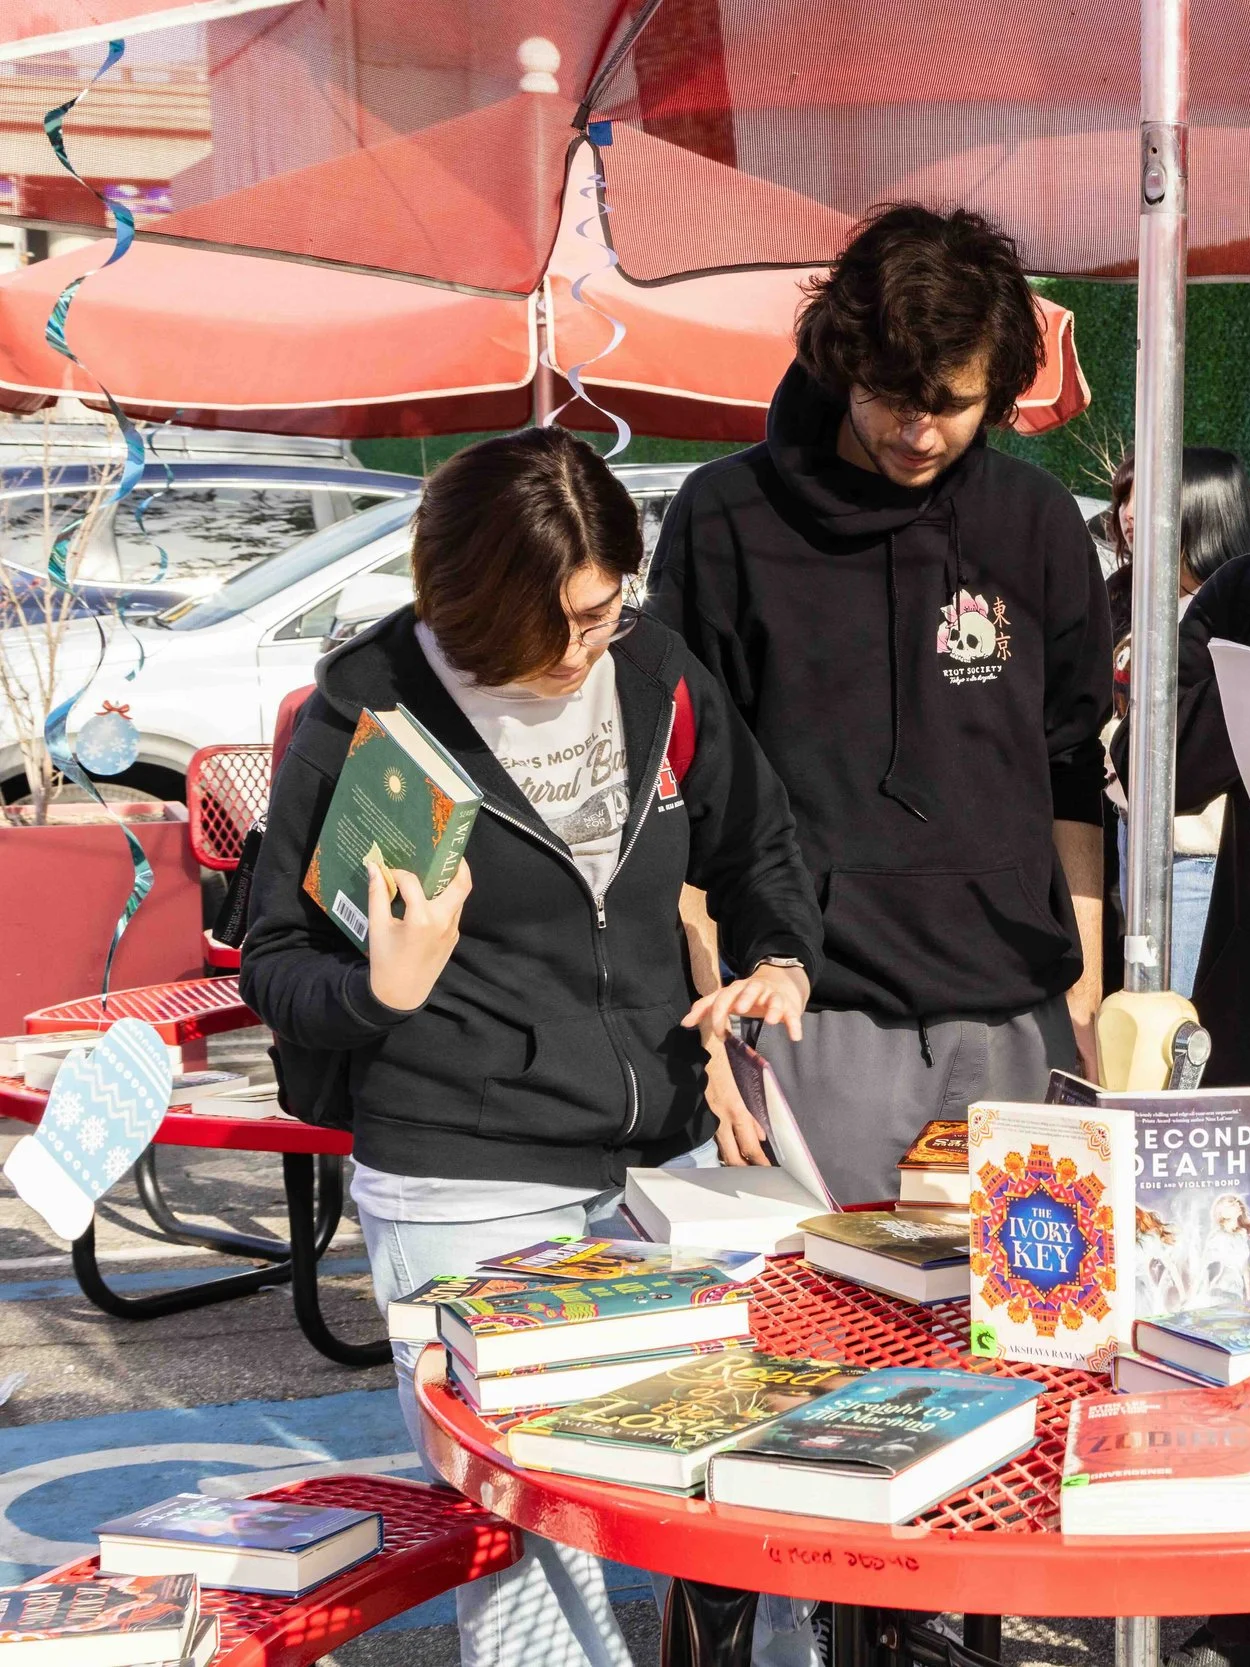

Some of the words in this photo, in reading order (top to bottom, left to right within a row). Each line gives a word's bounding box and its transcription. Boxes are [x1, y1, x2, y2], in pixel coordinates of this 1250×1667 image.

[991, 596, 1012, 661] 東京
[942, 668, 966, 677] RIOT
[967, 665, 1002, 674] SOCIETY
[501, 756, 541, 769] EAR'S
[547, 732, 599, 766] MODEL
[519, 766, 582, 806] tural
[582, 810, 604, 825] NEW
[585, 818, 606, 829] FOR
[451, 820, 471, 848] WE
[440, 850, 461, 876] ALL
[1135, 1149, 1246, 1178] DEATH
[1140, 1181, 1161, 1190] EDIE
[1178, 1180, 1211, 1188] VIOLET
[1215, 1179, 1241, 1187] BOND
[1032, 1207, 1052, 1219] THE
[1009, 1216, 1075, 1244] IVORY
[1012, 1240, 1074, 1274] KEY
[1009, 1345, 1049, 1357] AKSHAYA
[1052, 1350, 1085, 1361] RAMAN
[824, 1400, 923, 1415] Straight
[923, 1406, 956, 1421] On
[841, 1411, 936, 1433] Morning
[1090, 1468, 1173, 1480] ONVERGENCE
[18, 1591, 64, 1626] RISING
